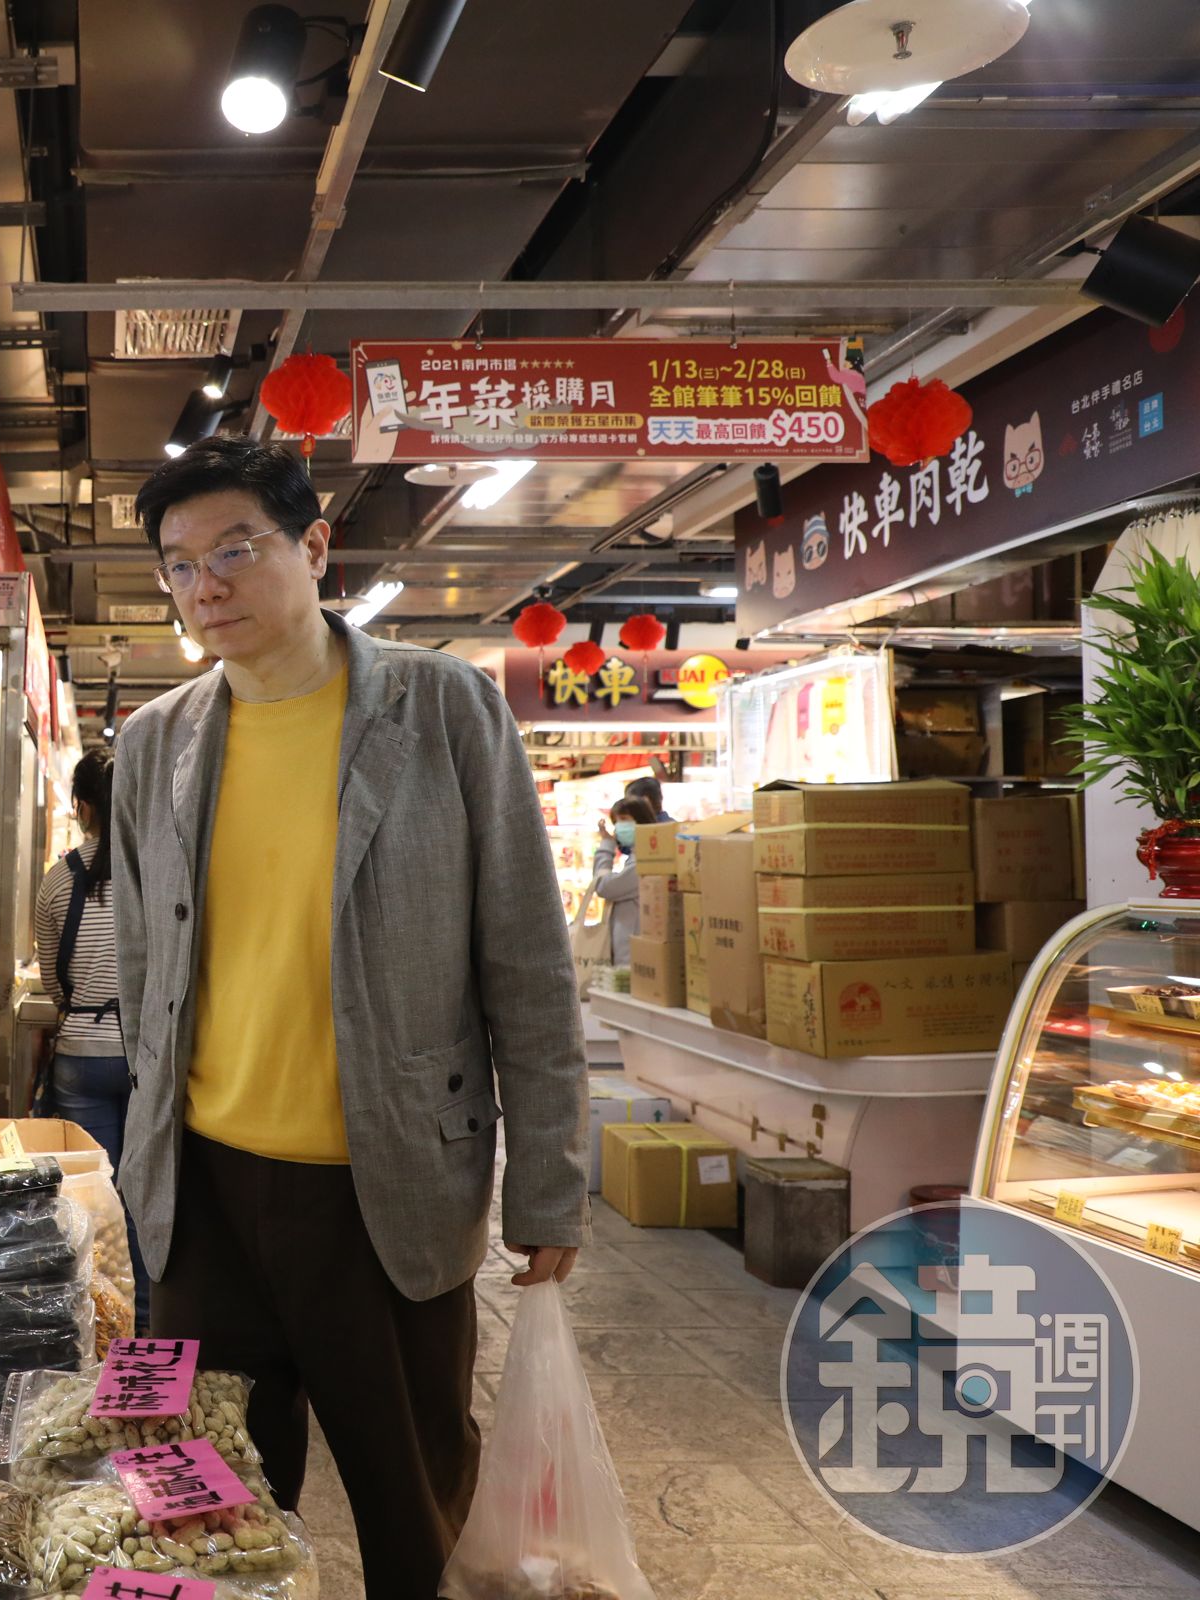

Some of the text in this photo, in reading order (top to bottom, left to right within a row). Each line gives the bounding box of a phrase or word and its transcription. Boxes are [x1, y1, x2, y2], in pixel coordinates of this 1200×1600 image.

[420, 358, 518, 371] 2021南門市場
[418, 376, 616, 430] 年菜採購月
[649, 385, 842, 408] 全館筆筆15%回饋
[838, 430, 990, 560] 快車肉乾
[548, 656, 640, 707] 快車
[660, 669, 705, 684] KUAI
[96, 1341, 184, 1411] 蒜味花生
